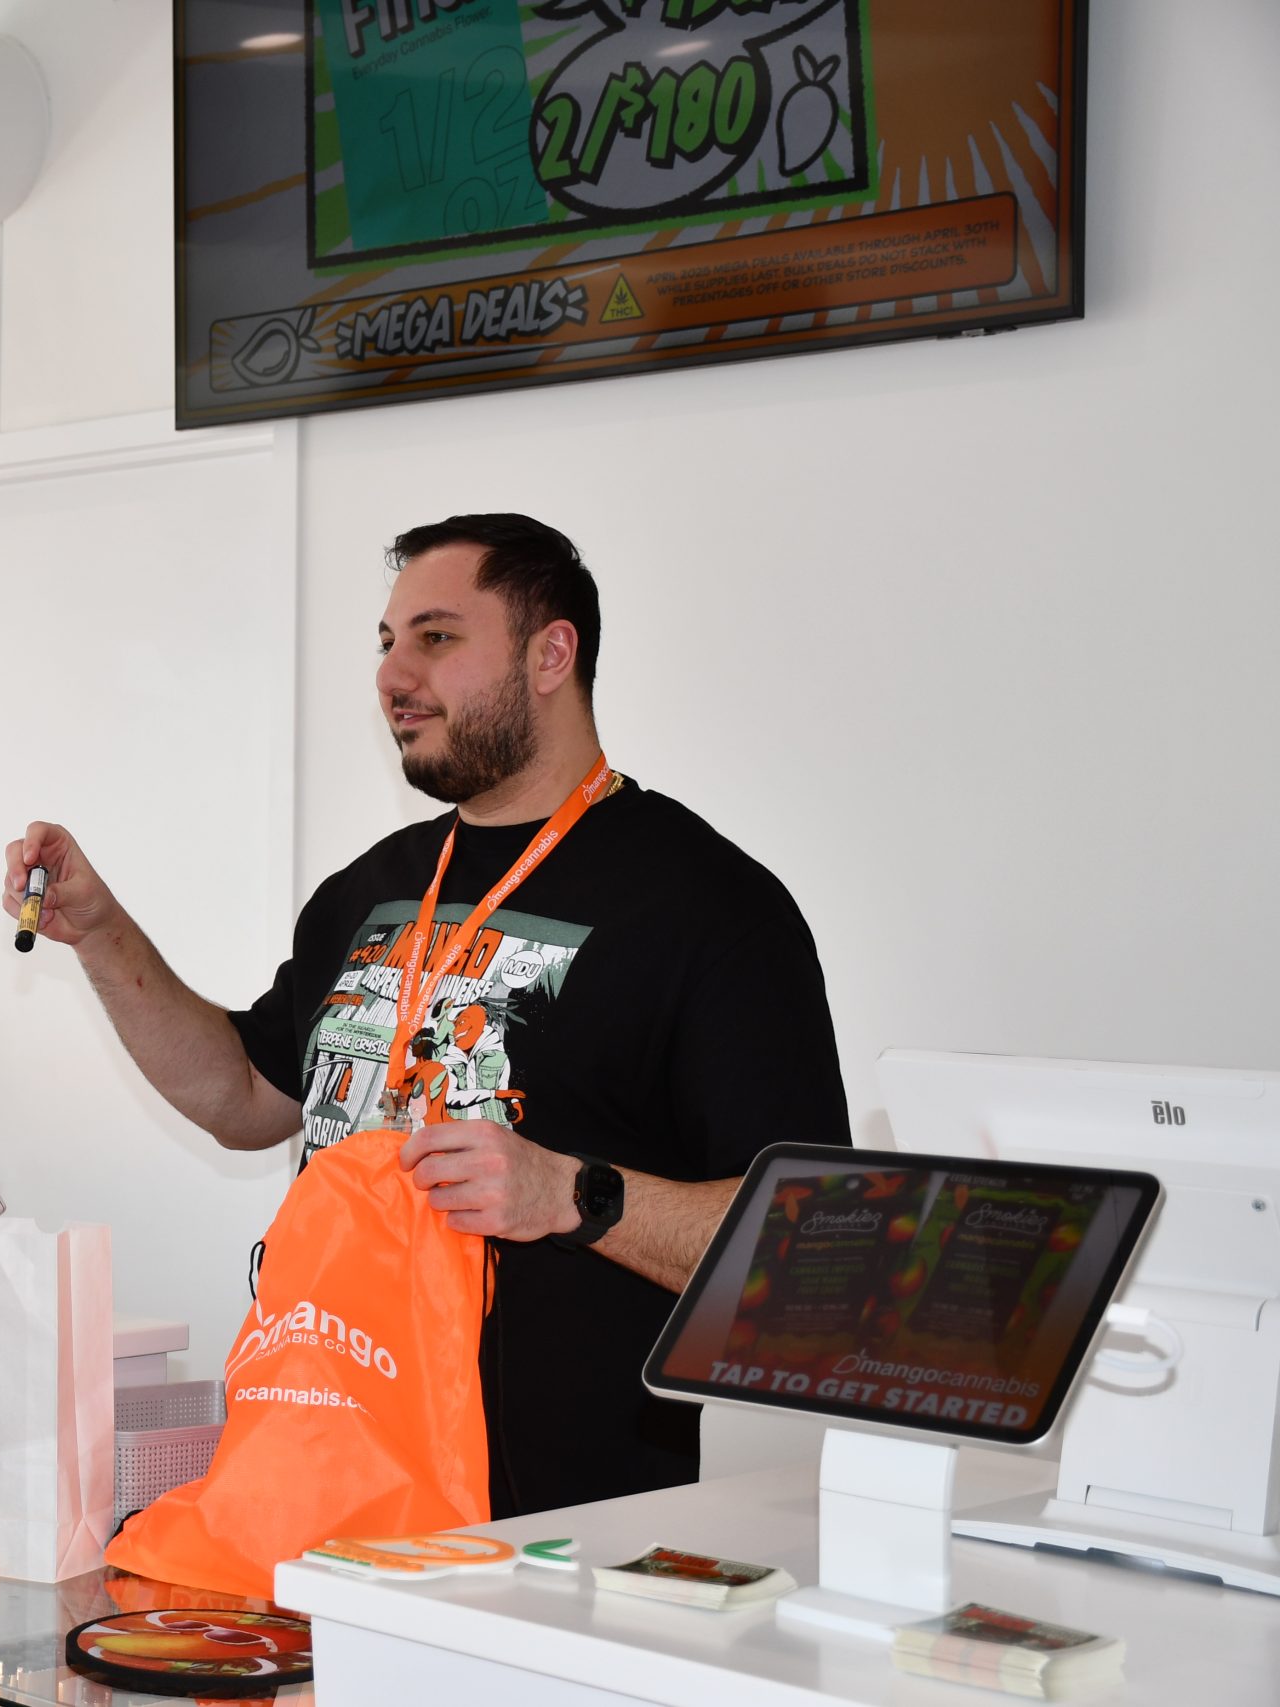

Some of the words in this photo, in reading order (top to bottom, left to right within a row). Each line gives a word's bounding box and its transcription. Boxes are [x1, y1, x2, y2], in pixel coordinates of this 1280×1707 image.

[351, 50, 399, 82] Everyday
[399, 24, 453, 56] Cannabis
[378, 44, 534, 194] 1/2
[536, 57, 760, 186] 2/$180
[646, 271, 677, 285] APRIL
[713, 262, 750, 275] MEGA
[752, 255, 790, 269] DEALS
[792, 243, 856, 262] AVAILABLE
[858, 233, 920, 250] THROUGH
[923, 227, 961, 241] APRIL
[964, 220, 1000, 235] 30TH
[657, 283, 691, 297] WHILE
[694, 274, 749, 291] SUPPLIES
[751, 269, 780, 282] LAST
[783, 263, 814, 276] BULK
[817, 257, 856, 272] DEALS
[858, 254, 877, 266] DO
[880, 250, 907, 262] NOT
[911, 243, 950, 257] STACK
[953, 237, 987, 252] WITH
[672, 286, 754, 307] PERCENTAGES
[756, 280, 779, 295] OFF
[782, 278, 801, 291] OR
[803, 271, 844, 287] OTHER
[847, 265, 887, 281] STORE
[351, 298, 453, 358] MEGA
[461, 279, 566, 342] DEALS
[494, 828, 559, 904] mangocannabis
[348, 943, 389, 965] #420
[381, 920, 505, 981] MNO
[503, 958, 542, 980] MDU
[400, 942, 424, 1023] mangocannabis
[416, 943, 463, 1029] mangocannabis
[319, 1029, 353, 1050] TERPENE
[796, 1238, 877, 1251] mangocannabis
[800, 1208, 883, 1235] Smokiez
[965, 1203, 1048, 1236] Smokiez
[255, 1332, 319, 1361] CANNABIS
[324, 1338, 346, 1355] CO
[261, 1301, 398, 1379] mango
[709, 1361, 765, 1387] TAP
[770, 1370, 810, 1393] TO
[816, 1377, 880, 1402] GET
[880, 1387, 1030, 1427] STARTED
[860, 1359, 1041, 1398] mangocannabis
